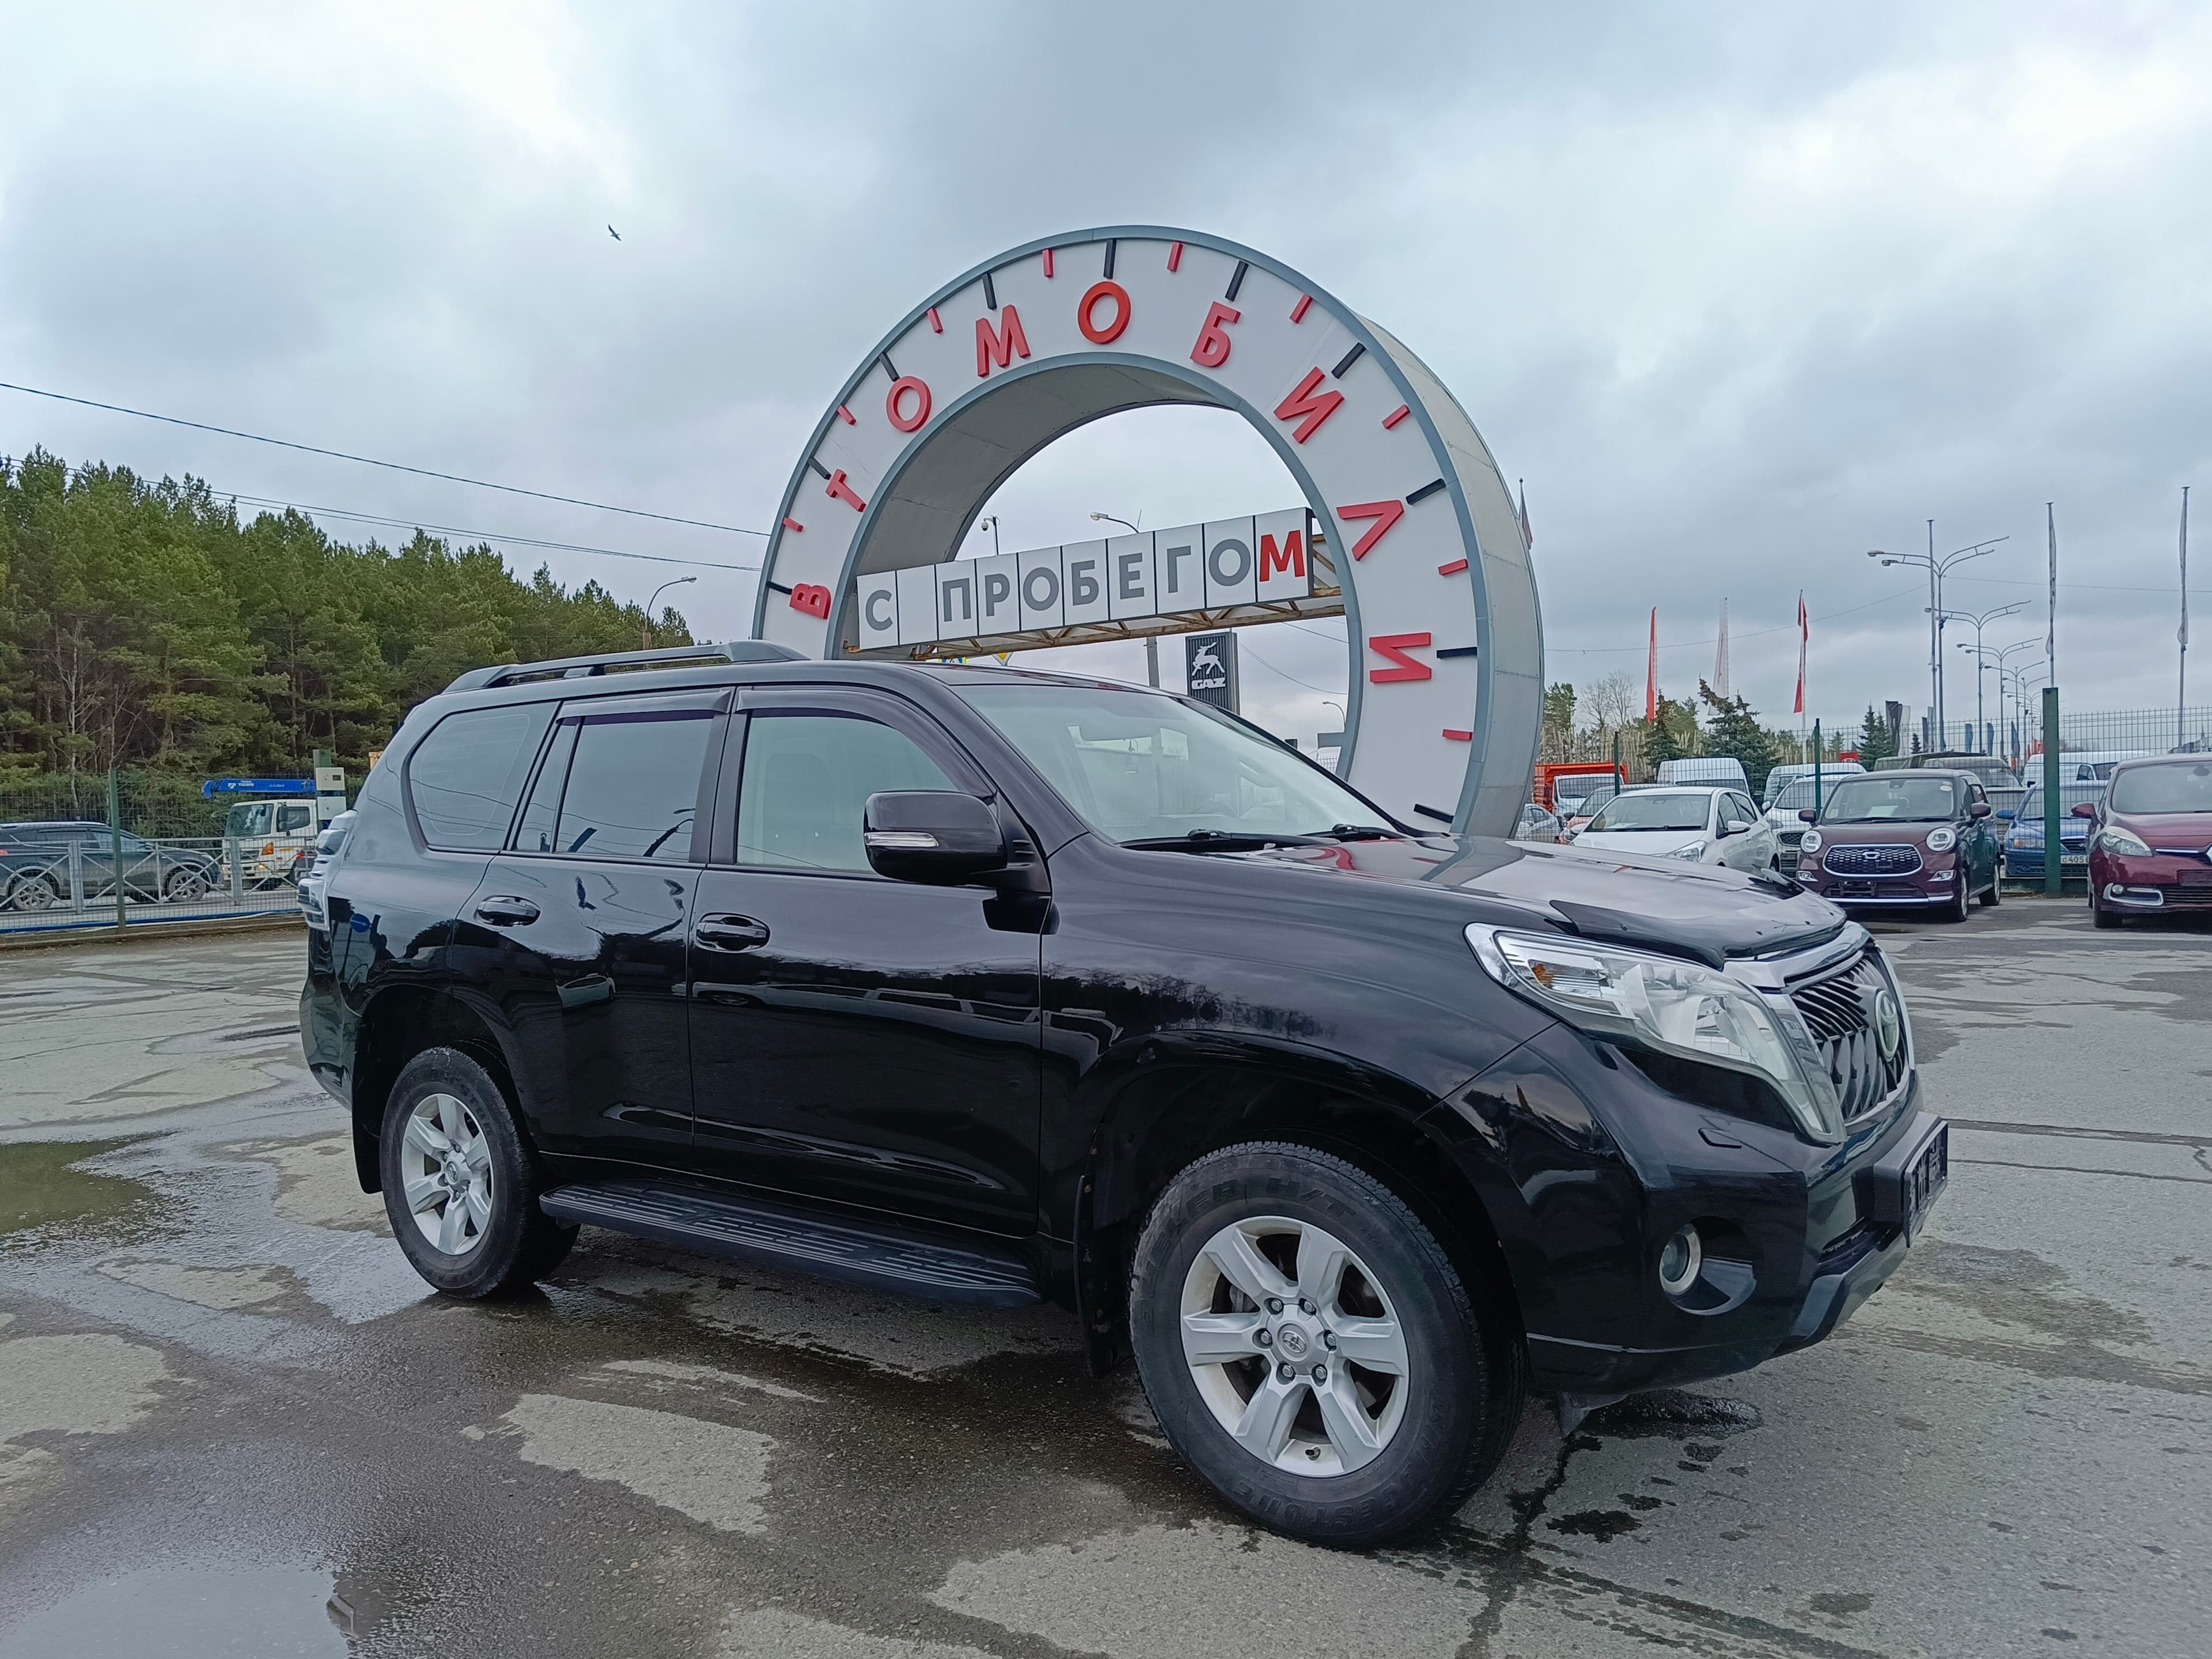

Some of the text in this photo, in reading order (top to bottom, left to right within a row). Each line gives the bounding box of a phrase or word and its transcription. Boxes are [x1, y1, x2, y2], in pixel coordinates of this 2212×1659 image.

[789, 281, 1432, 683] ВТОМОБИЛИ
[865, 529, 1306, 632] С ПРОБЕГОМ
[1191, 677, 1226, 690] GAZ
